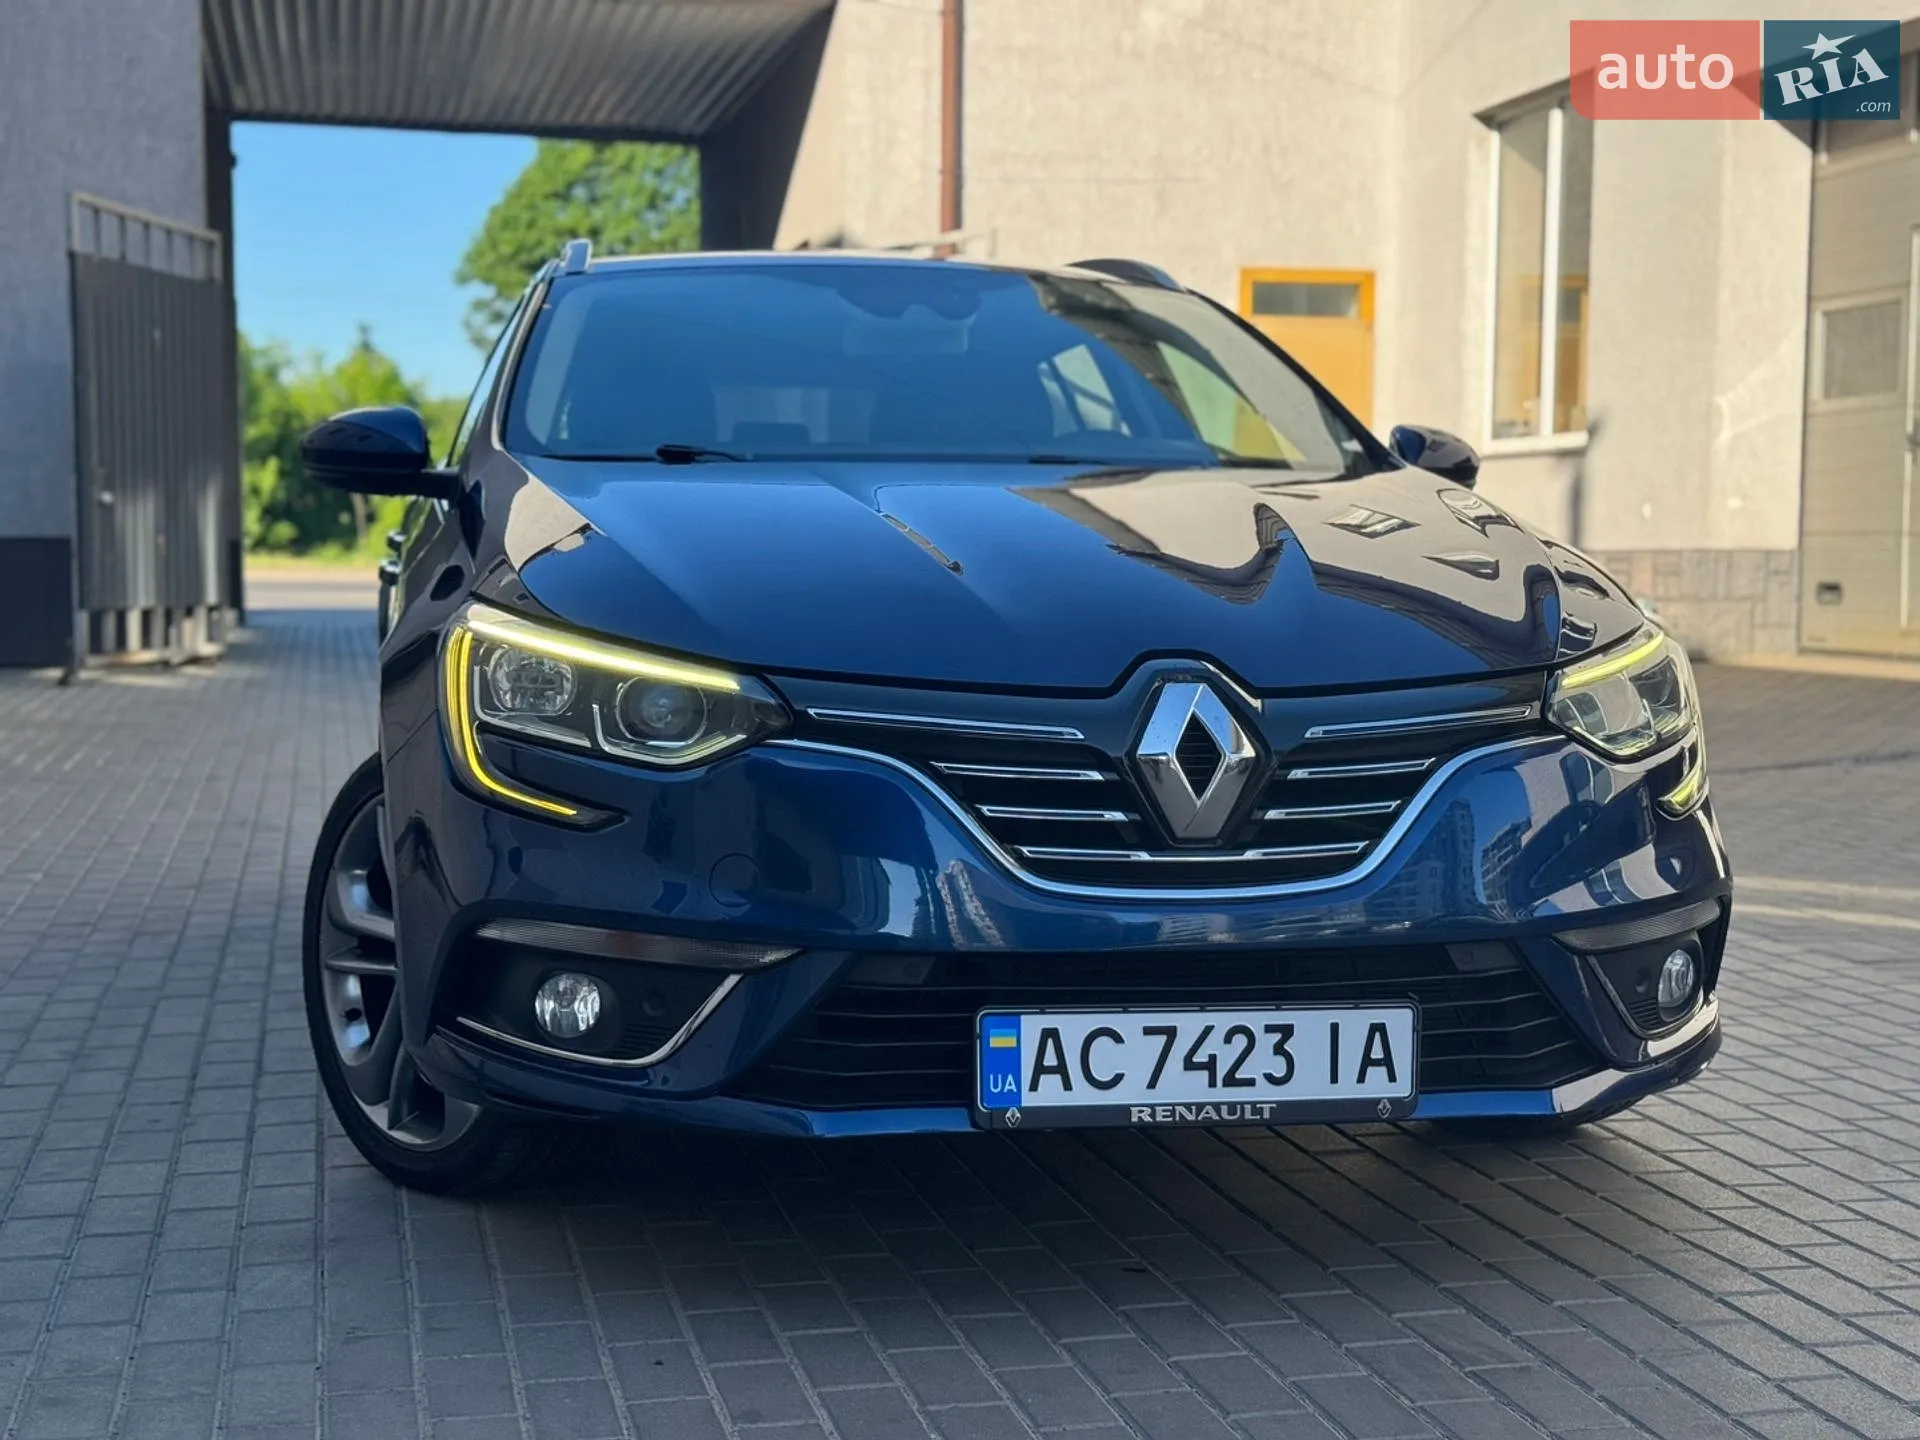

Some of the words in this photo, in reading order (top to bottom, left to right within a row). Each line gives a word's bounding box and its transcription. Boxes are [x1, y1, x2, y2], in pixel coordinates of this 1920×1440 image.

[1028, 1026, 1125, 1092] AC
[1142, 1023, 1295, 1090] 7423
[1329, 1021, 1397, 1085] IA
[989, 1074, 1017, 1093] UA
[1129, 1103, 1277, 1123] RENAULT
